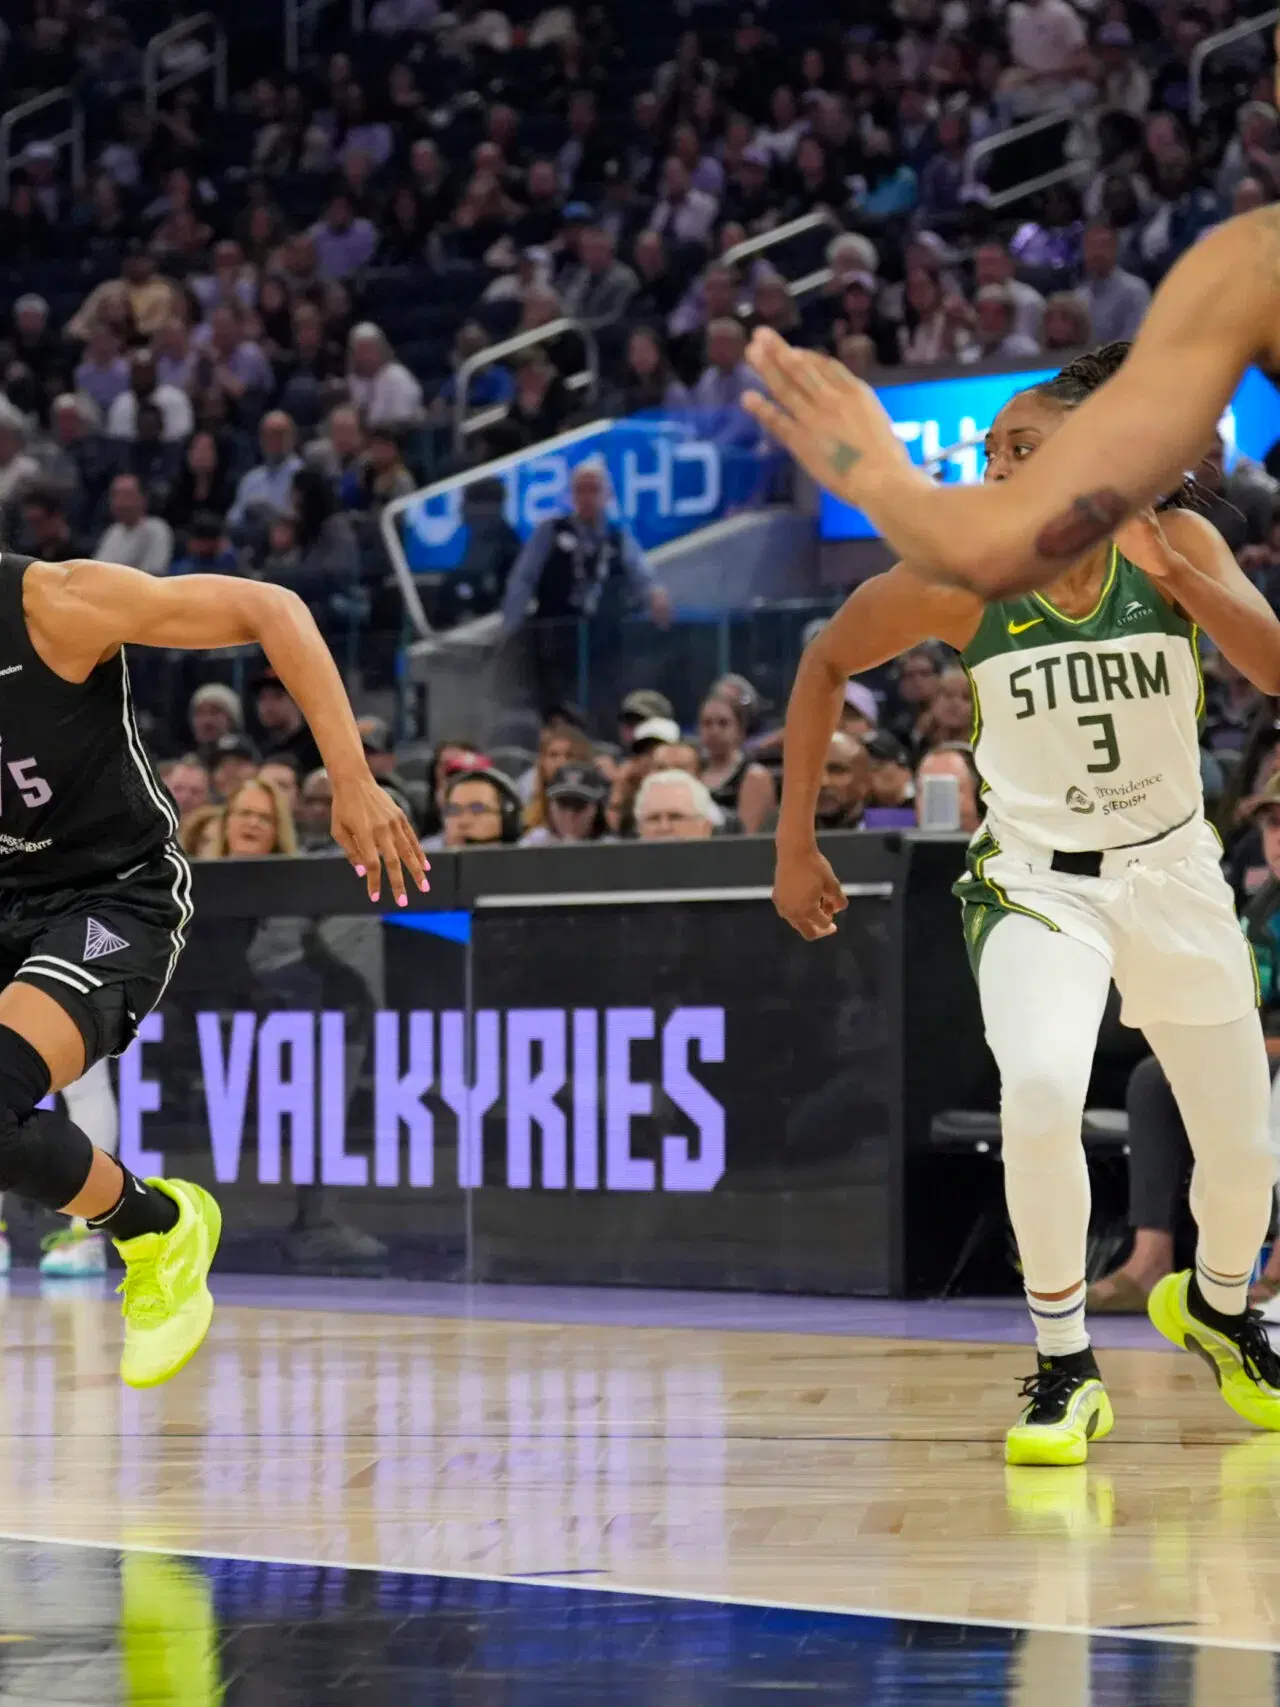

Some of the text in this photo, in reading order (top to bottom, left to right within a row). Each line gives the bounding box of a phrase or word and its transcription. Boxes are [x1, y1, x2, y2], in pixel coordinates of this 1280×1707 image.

[1009, 651, 1170, 720] STORM
[1077, 713, 1121, 773] 3
[7, 757, 53, 808] 5
[1093, 773, 1163, 799] Providence
[196, 1006, 726, 1192] VALKYRIES
